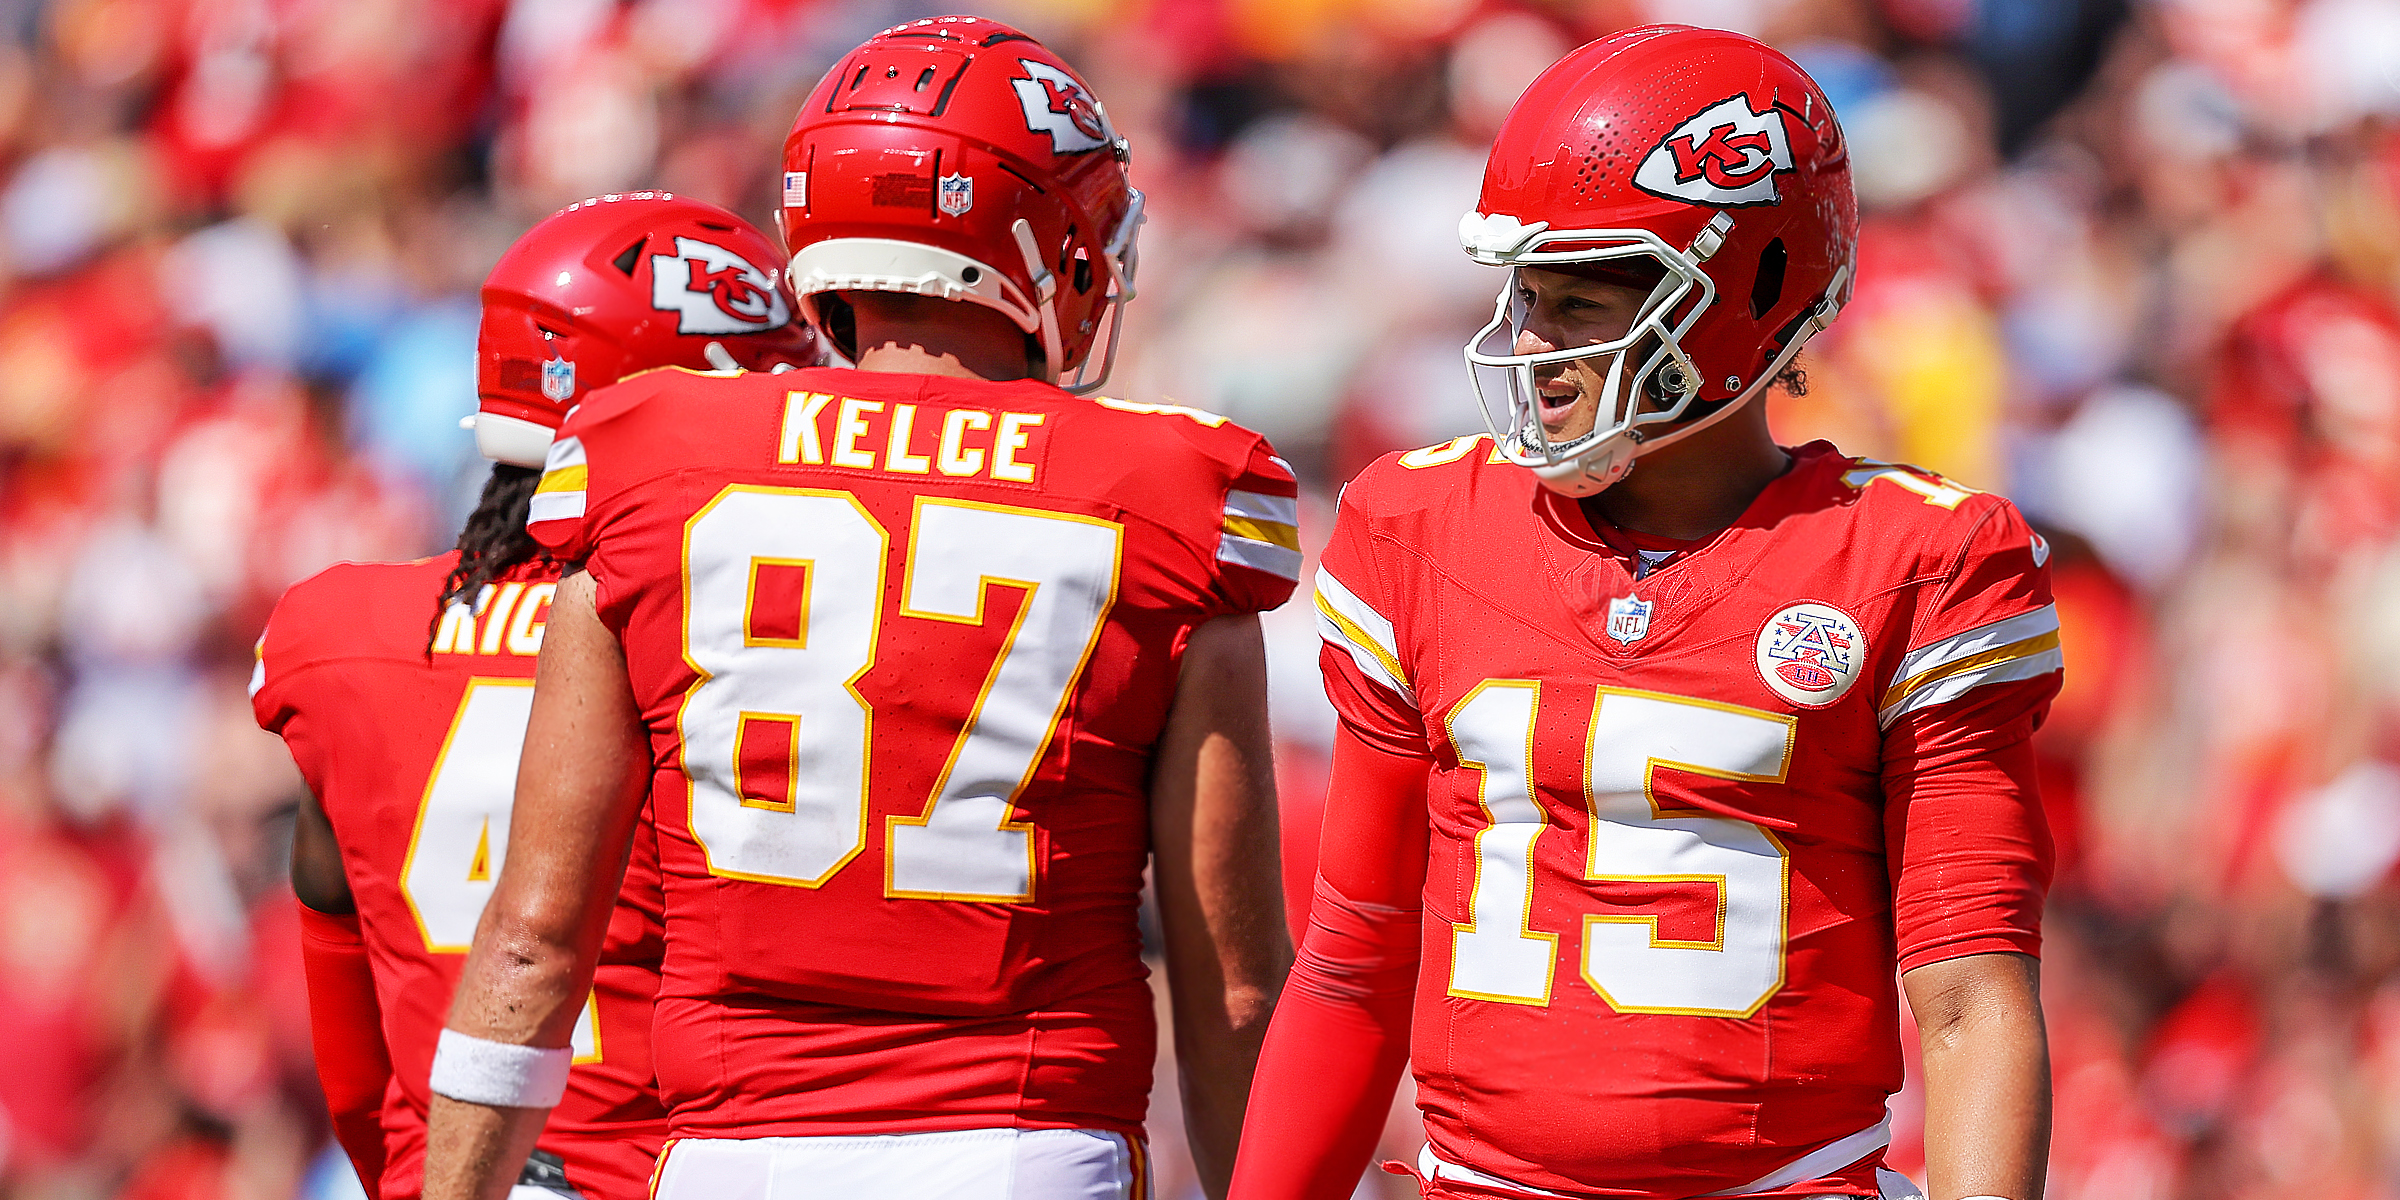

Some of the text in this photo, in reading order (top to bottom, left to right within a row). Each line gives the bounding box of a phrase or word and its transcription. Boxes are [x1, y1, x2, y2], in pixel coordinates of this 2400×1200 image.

[1665, 122, 1776, 191] KC
[683, 258, 772, 324] KC
[777, 391, 1046, 483] KELCE
[1613, 616, 1641, 635] NFL
[676, 483, 1126, 904] 87
[1444, 678, 1798, 1019] 15
